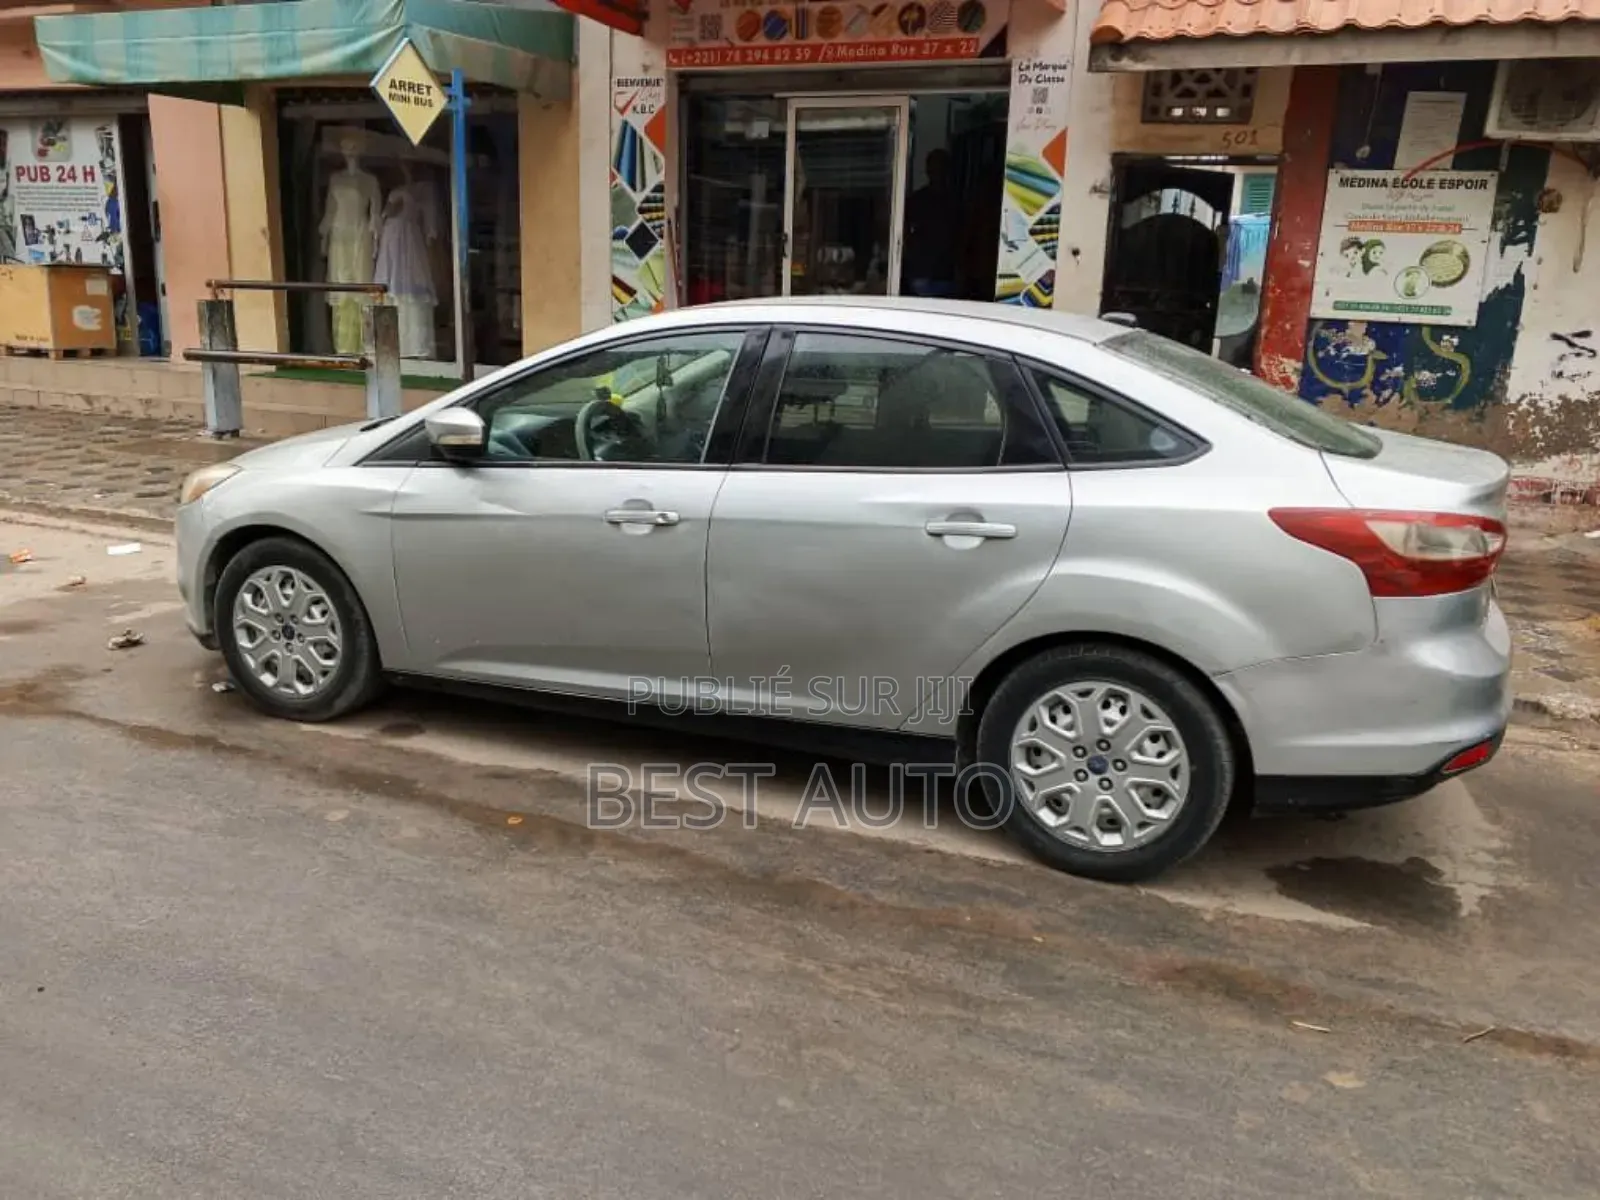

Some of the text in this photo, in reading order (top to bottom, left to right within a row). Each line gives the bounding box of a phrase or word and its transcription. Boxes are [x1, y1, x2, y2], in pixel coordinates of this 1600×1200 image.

[388, 78, 433, 96] ARRET
[388, 91, 434, 108] MINI BUS
[1222, 130, 1258, 149] 501
[15, 165, 96, 183] PUB 24 H
[1338, 177, 1389, 189] MEDINA
[1438, 178, 1489, 190] ESPOIR
